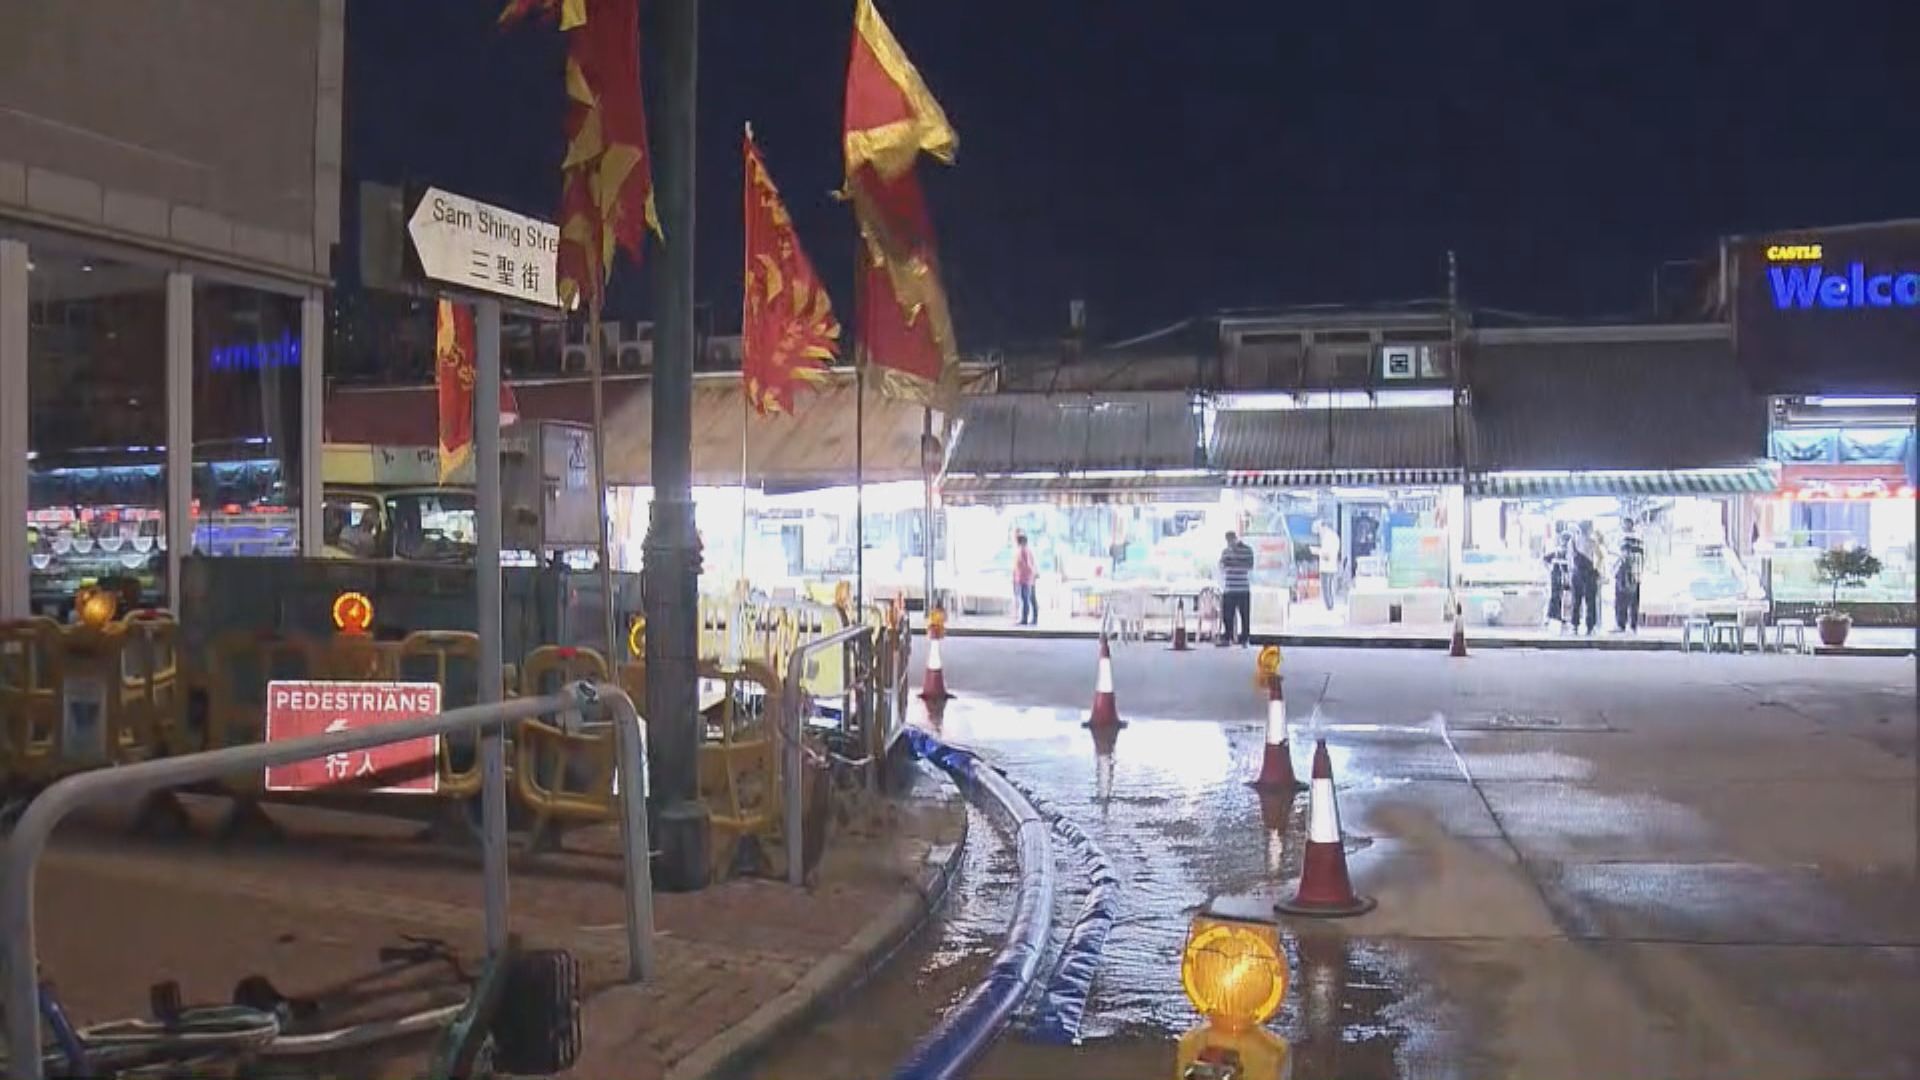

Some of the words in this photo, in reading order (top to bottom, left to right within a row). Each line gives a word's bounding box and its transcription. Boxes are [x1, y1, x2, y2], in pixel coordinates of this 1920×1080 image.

[432, 198, 472, 228] Sam
[478, 208, 521, 248] Shing
[1766, 244, 1822, 261] CASTLE
[469, 250, 540, 293] 三聖街
[1768, 260, 1920, 310] Welco
[276, 691, 431, 713] PEDESTRIANS
[325, 752, 376, 780] 行人
